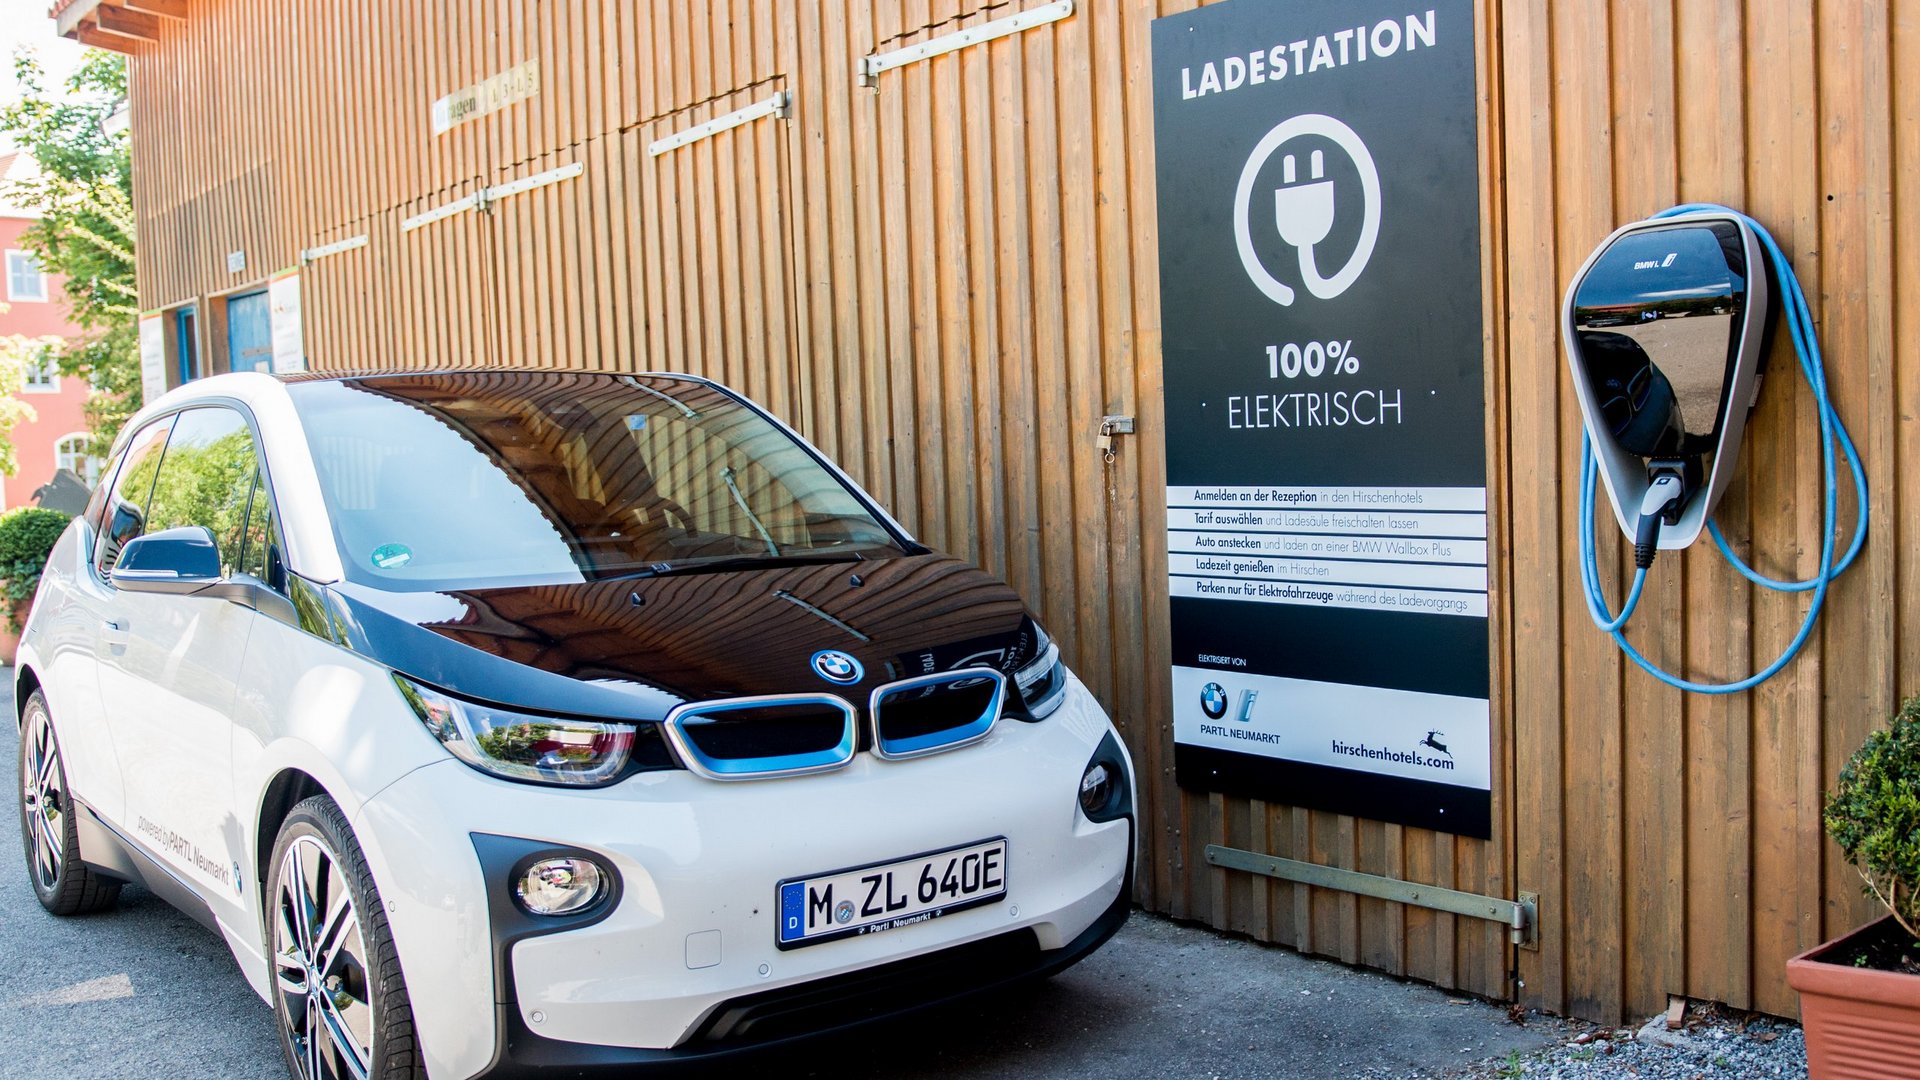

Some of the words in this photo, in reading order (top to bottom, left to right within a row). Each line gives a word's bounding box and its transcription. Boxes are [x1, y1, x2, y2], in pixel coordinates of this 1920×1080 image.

[1181, 9, 1437, 100] LADESTATION
[1634, 261, 1653, 270] BMW
[1266, 340, 1360, 379] 100%
[1228, 388, 1402, 429] ELEKTRISCH
[1195, 489, 1238, 501] Anmelden
[1240, 492, 1251, 501] an
[1254, 490, 1269, 502] der
[1272, 490, 1317, 505] Rezeption
[1320, 491, 1328, 502] in
[1332, 491, 1349, 503] den
[1353, 491, 1422, 504] Hirschenhotels
[1195, 513, 1213, 524] Tarif
[1216, 514, 1262, 525] auswählen
[1266, 515, 1281, 526] und
[1285, 516, 1329, 527] Ladesäule
[1332, 516, 1384, 528] freischalten
[1389, 517, 1418, 529] lassen
[1196, 536, 1215, 548] Auto
[1218, 537, 1261, 549] anstecken
[1264, 538, 1280, 550] und
[1283, 539, 1307, 551] laden
[1311, 543, 1323, 552] an
[1326, 541, 1349, 552] einer
[1353, 541, 1382, 553] BMW
[1386, 542, 1427, 555] Wallbox
[1433, 543, 1451, 556] Plus
[1196, 559, 1231, 571] Ladezeit
[1234, 561, 1274, 575] genießen
[1277, 563, 1287, 574] im
[1290, 564, 1329, 576] Hirschen
[1197, 582, 1225, 593] Parken
[1228, 585, 1242, 595] nur
[1244, 584, 1256, 596] für
[1259, 585, 1333, 603] Elektrofahrzeuge
[1337, 591, 1376, 604] während
[1379, 593, 1396, 605] des
[1400, 594, 1467, 611] Ladevorgangs
[1199, 654, 1230, 664] ELEKTRISIERT
[1231, 657, 1247, 666] VON
[1201, 724, 1228, 737] PARTL
[1230, 729, 1280, 744] NEUMARKT
[1332, 740, 1454, 770] hirschenhotels.com
[138, 816, 162, 842] powered
[169, 831, 192, 862] PARTL
[193, 846, 229, 885] Neumarkt
[808, 883, 833, 928] M
[861, 872, 907, 918] ZL
[918, 848, 1002, 903] 640E
[789, 916, 798, 929] D
[870, 922, 890, 933] Partl
[893, 912, 931, 927] Neumarkt
